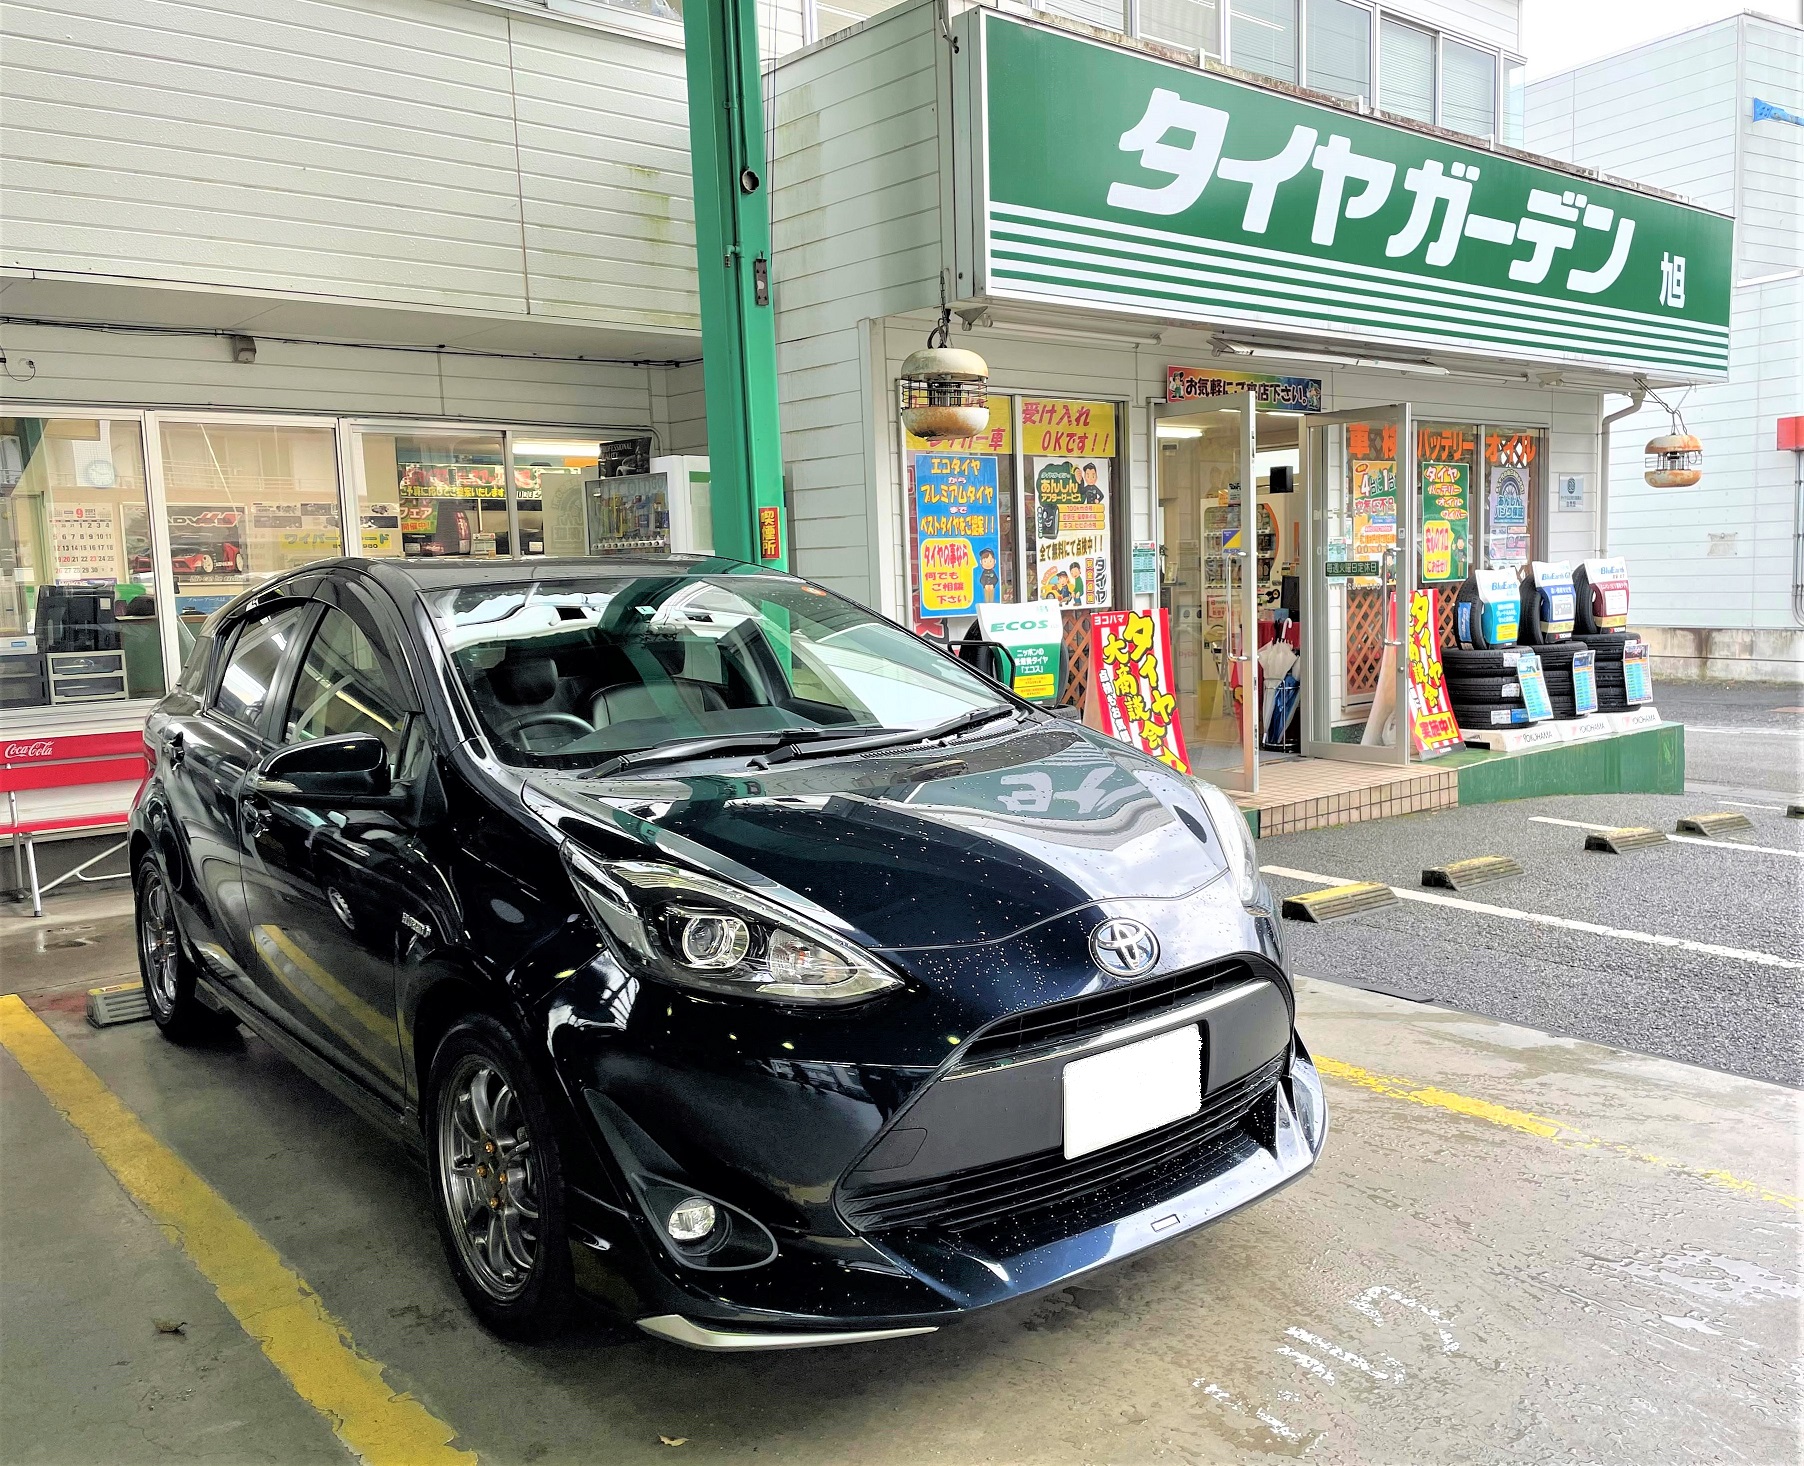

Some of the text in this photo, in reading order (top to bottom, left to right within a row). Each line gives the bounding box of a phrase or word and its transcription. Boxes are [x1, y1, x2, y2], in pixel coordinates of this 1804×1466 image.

[1107, 88, 1686, 309] タイヤガーデン 旭
[1022, 402, 1091, 426] 受け入れ
[1417, 428, 1474, 460] バッテリー
[1485, 433, 1536, 463] オイル
[931, 458, 980, 475] エコタイヤ
[1426, 466, 1458, 482] タイヤ
[921, 485, 993, 504] プレミアムタイヤ
[1041, 479, 1078, 493] あんしん
[1041, 493, 1082, 502] アフターサービス
[76, 508, 83, 518] 9
[761, 510, 777, 555] 喫煙所
[925, 572, 959, 580] 何でも
[1096, 557, 1107, 605] タイヤ
[932, 583, 964, 592] ご相談
[990, 620, 1049, 632] ECOS
[1094, 614, 1125, 625] ヨコハマ
[1411, 592, 1443, 688] タイヤ
[1124, 612, 1176, 723] タイヤ
[1103, 633, 1166, 749] 大商談会
[1419, 717, 1455, 738] 実施中!
